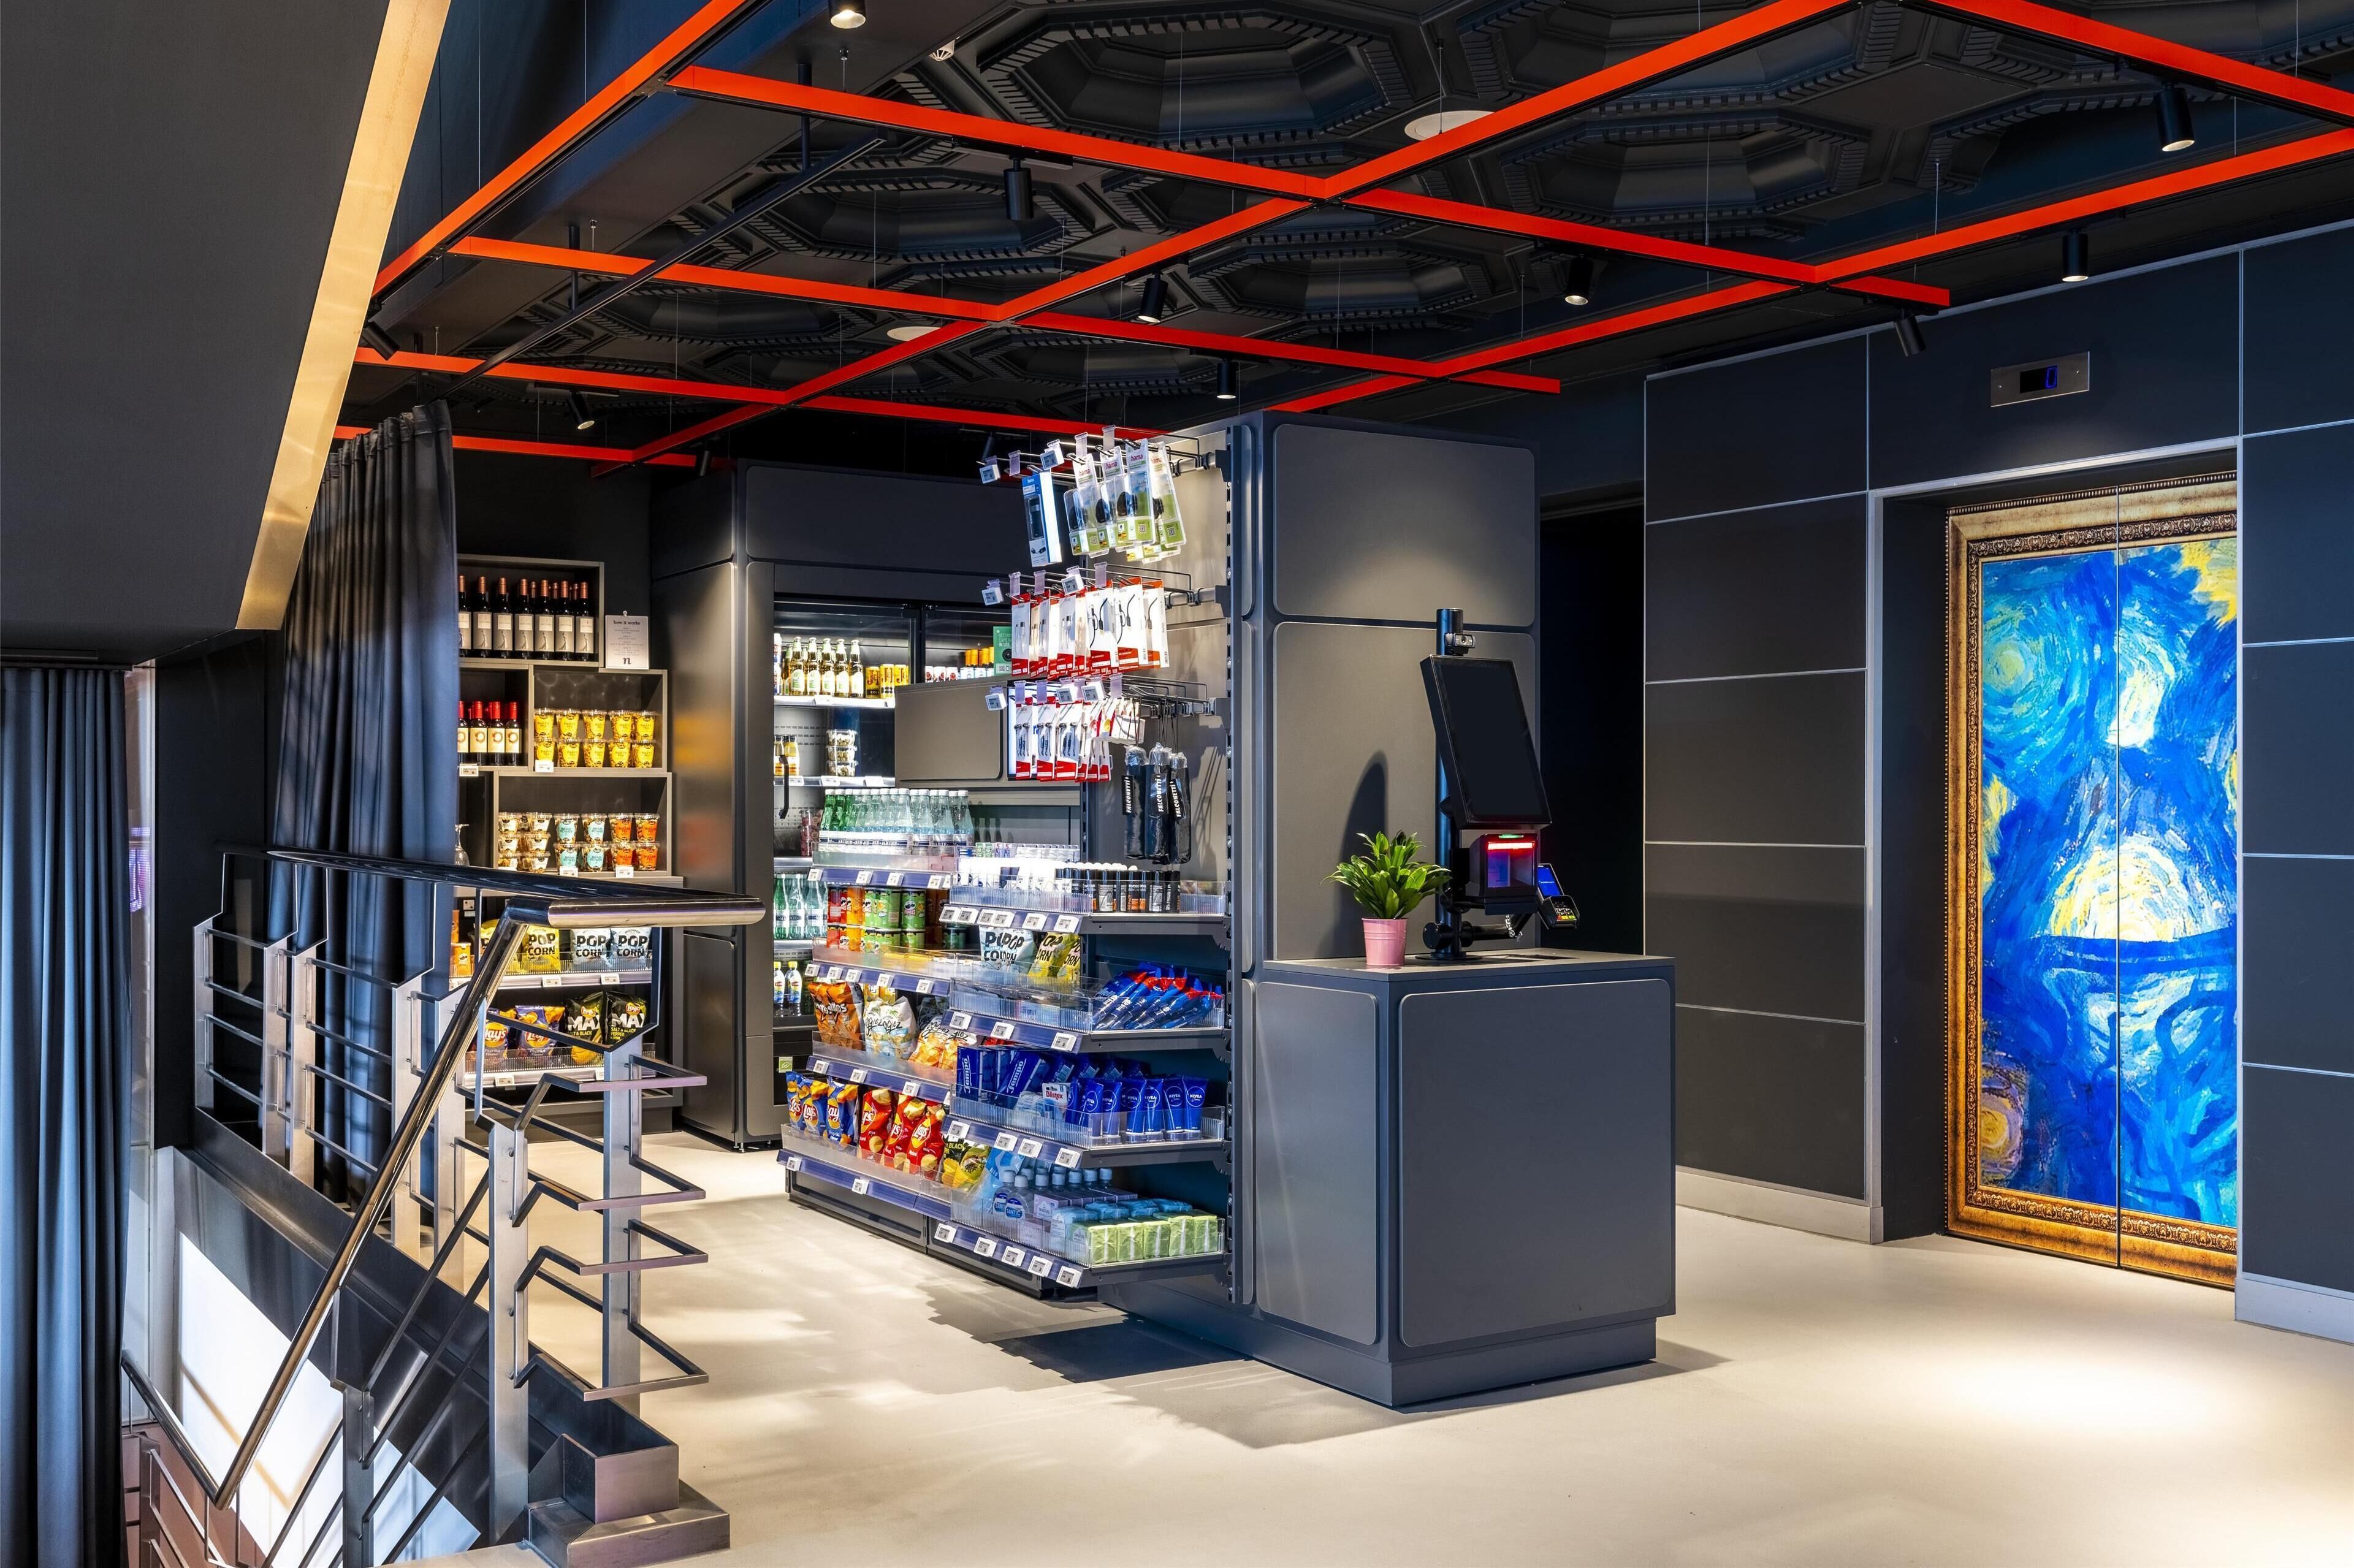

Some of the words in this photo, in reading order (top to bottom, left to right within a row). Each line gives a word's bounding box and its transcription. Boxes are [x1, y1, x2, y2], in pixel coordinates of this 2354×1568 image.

[2046, 367, 2058, 389] 0
[1106, 461, 1117, 470] hama
[1079, 468, 1090, 478] hama
[529, 933, 555, 945] POP
[577, 935, 606, 947] POP
[619, 935, 648, 947] POP
[1043, 935, 1063, 947] OP
[528, 946, 555, 956] CORN
[617, 949, 644, 957] CORN
[1008, 1060, 1025, 1094] Tempo
[1046, 1090, 1064, 1100] Blistex
